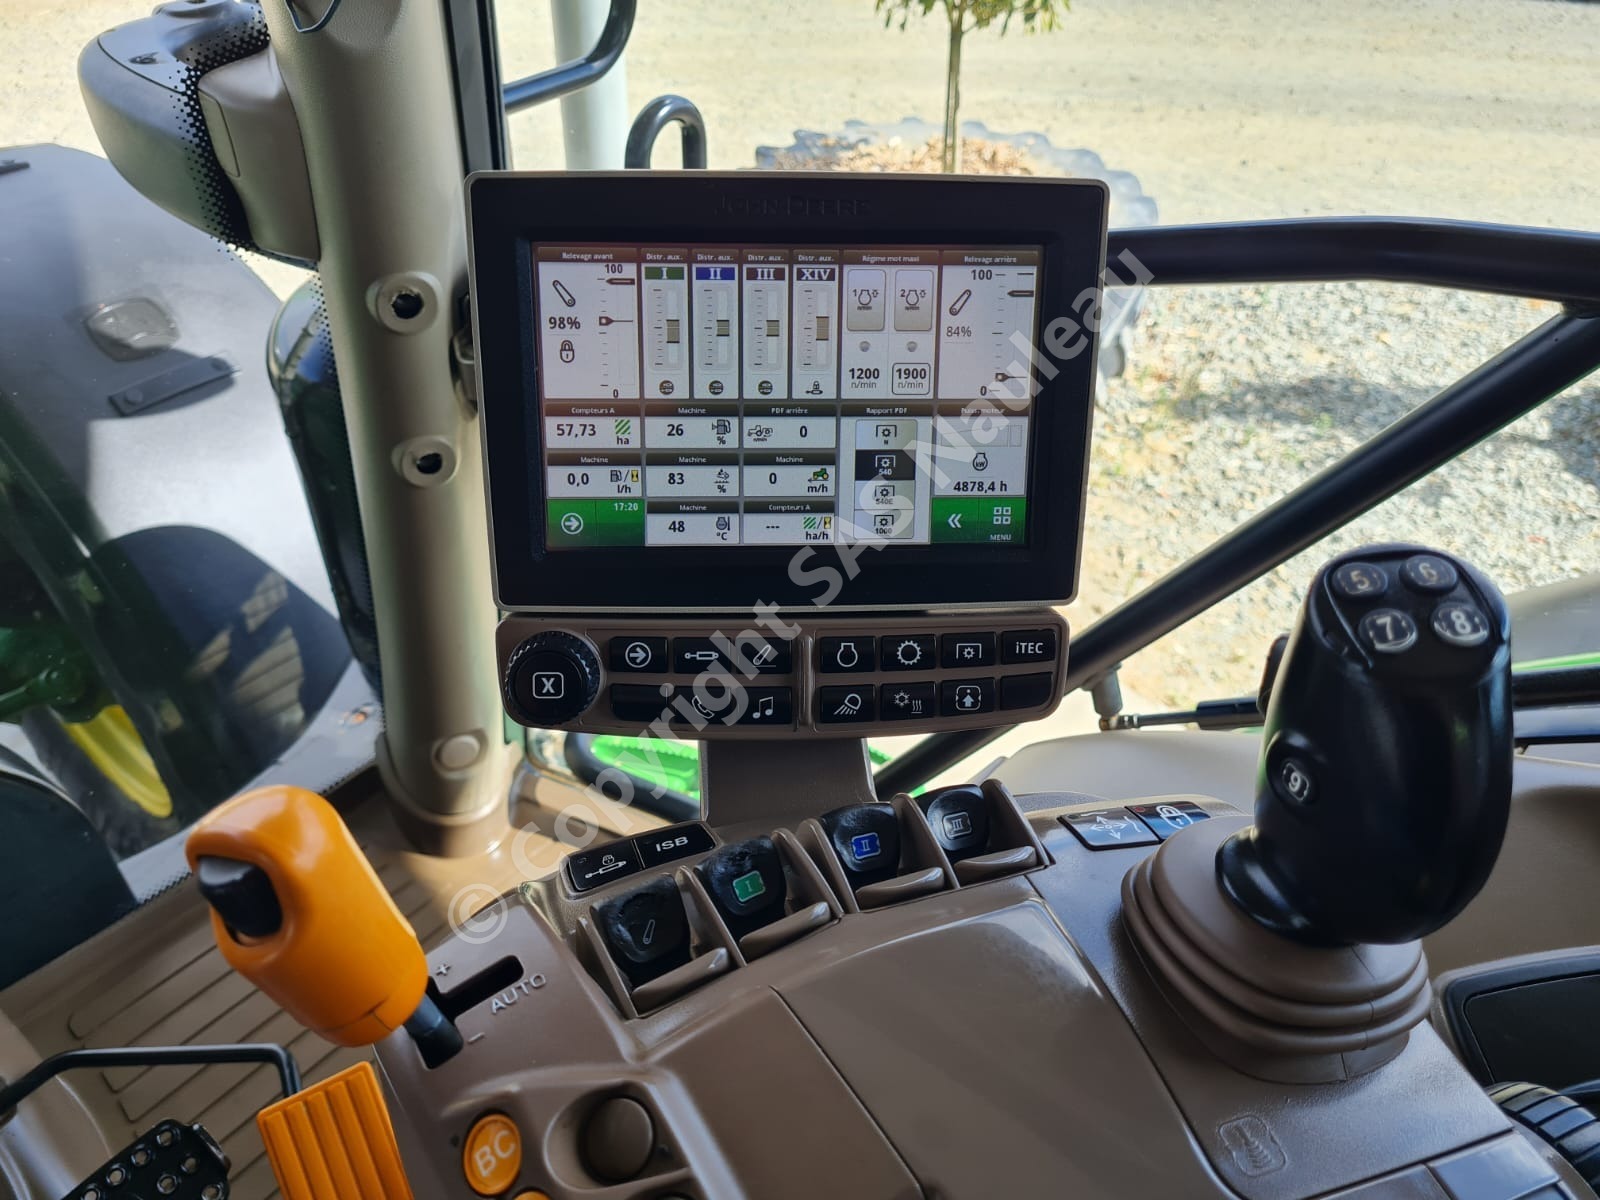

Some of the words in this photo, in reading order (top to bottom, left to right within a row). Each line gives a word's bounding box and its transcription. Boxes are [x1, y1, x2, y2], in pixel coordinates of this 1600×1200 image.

[604, 263, 623, 274] 100
[709, 267, 721, 279] II
[756, 267, 775, 280] III
[800, 268, 831, 280] XIV
[970, 269, 993, 280] 100
[900, 289, 906, 297] 2
[548, 316, 581, 329] 98%
[946, 326, 972, 338] 84%
[849, 368, 879, 380] 1200
[896, 368, 926, 380] 1900
[851, 380, 877, 389] n/min
[898, 380, 924, 389] n/min
[980, 385, 987, 396] 0
[613, 388, 619, 398] 0
[571, 407, 609, 415] Compteurs
[866, 407, 893, 415] Rapport
[556, 423, 597, 438] 57,73
[666, 424, 684, 436] 26
[799, 425, 808, 438] 0
[616, 436, 630, 445] ha
[716, 436, 726, 445] %
[567, 473, 590, 488] 0,0
[667, 472, 685, 485] 83
[769, 472, 777, 485] 0
[617, 484, 631, 494] l/h
[807, 484, 828, 493] m/h
[953, 480, 996, 494] 4878,4
[1000, 480, 1007, 492] h
[613, 502, 638, 511] 17:20
[768, 504, 804, 512] Compteurs
[668, 520, 685, 533] 48
[805, 531, 829, 540] ha/h
[1418, 562, 1438, 582] 6
[1350, 570, 1370, 590] 5
[1375, 615, 1394, 641] 7
[1450, 610, 1471, 634] 8
[1015, 642, 1043, 654] iTEC
[541, 677, 555, 693] X
[1288, 771, 1302, 793] 9
[656, 836, 689, 852] ISB
[490, 973, 547, 1014] AUTO
[474, 1130, 516, 1178] BC
